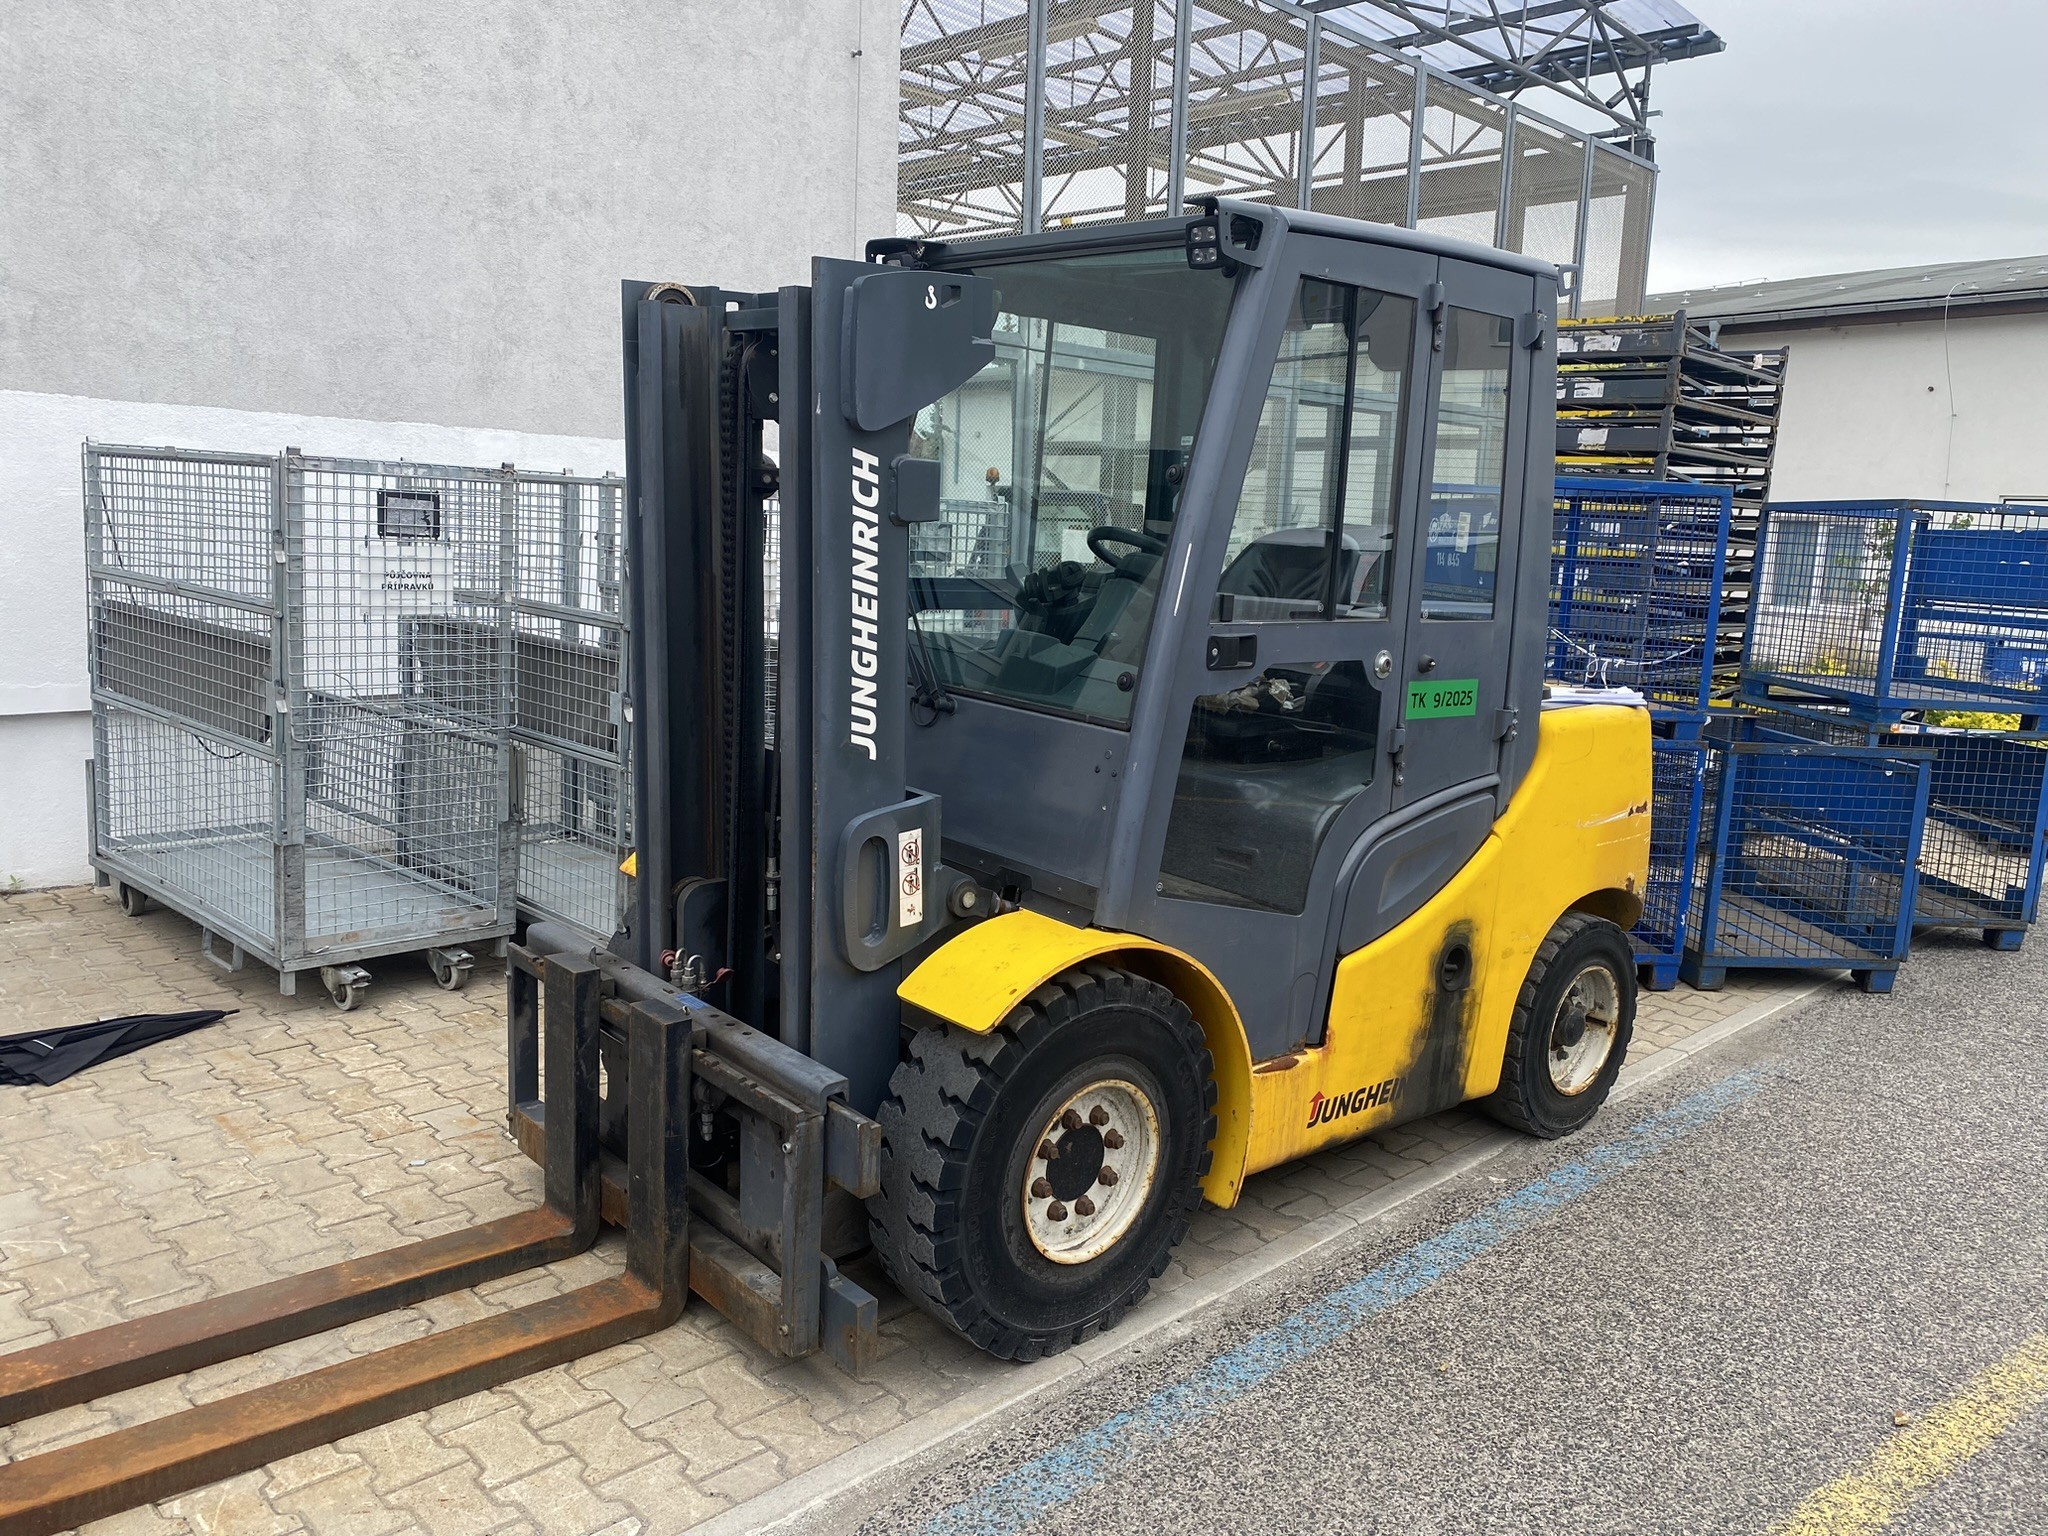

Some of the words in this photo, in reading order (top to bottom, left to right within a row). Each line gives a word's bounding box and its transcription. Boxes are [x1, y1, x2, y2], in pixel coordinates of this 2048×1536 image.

[850, 447, 879, 760] JUNGHEINRICH
[1411, 692, 1427, 708] TK
[1433, 690, 1473, 708] 9/2025
